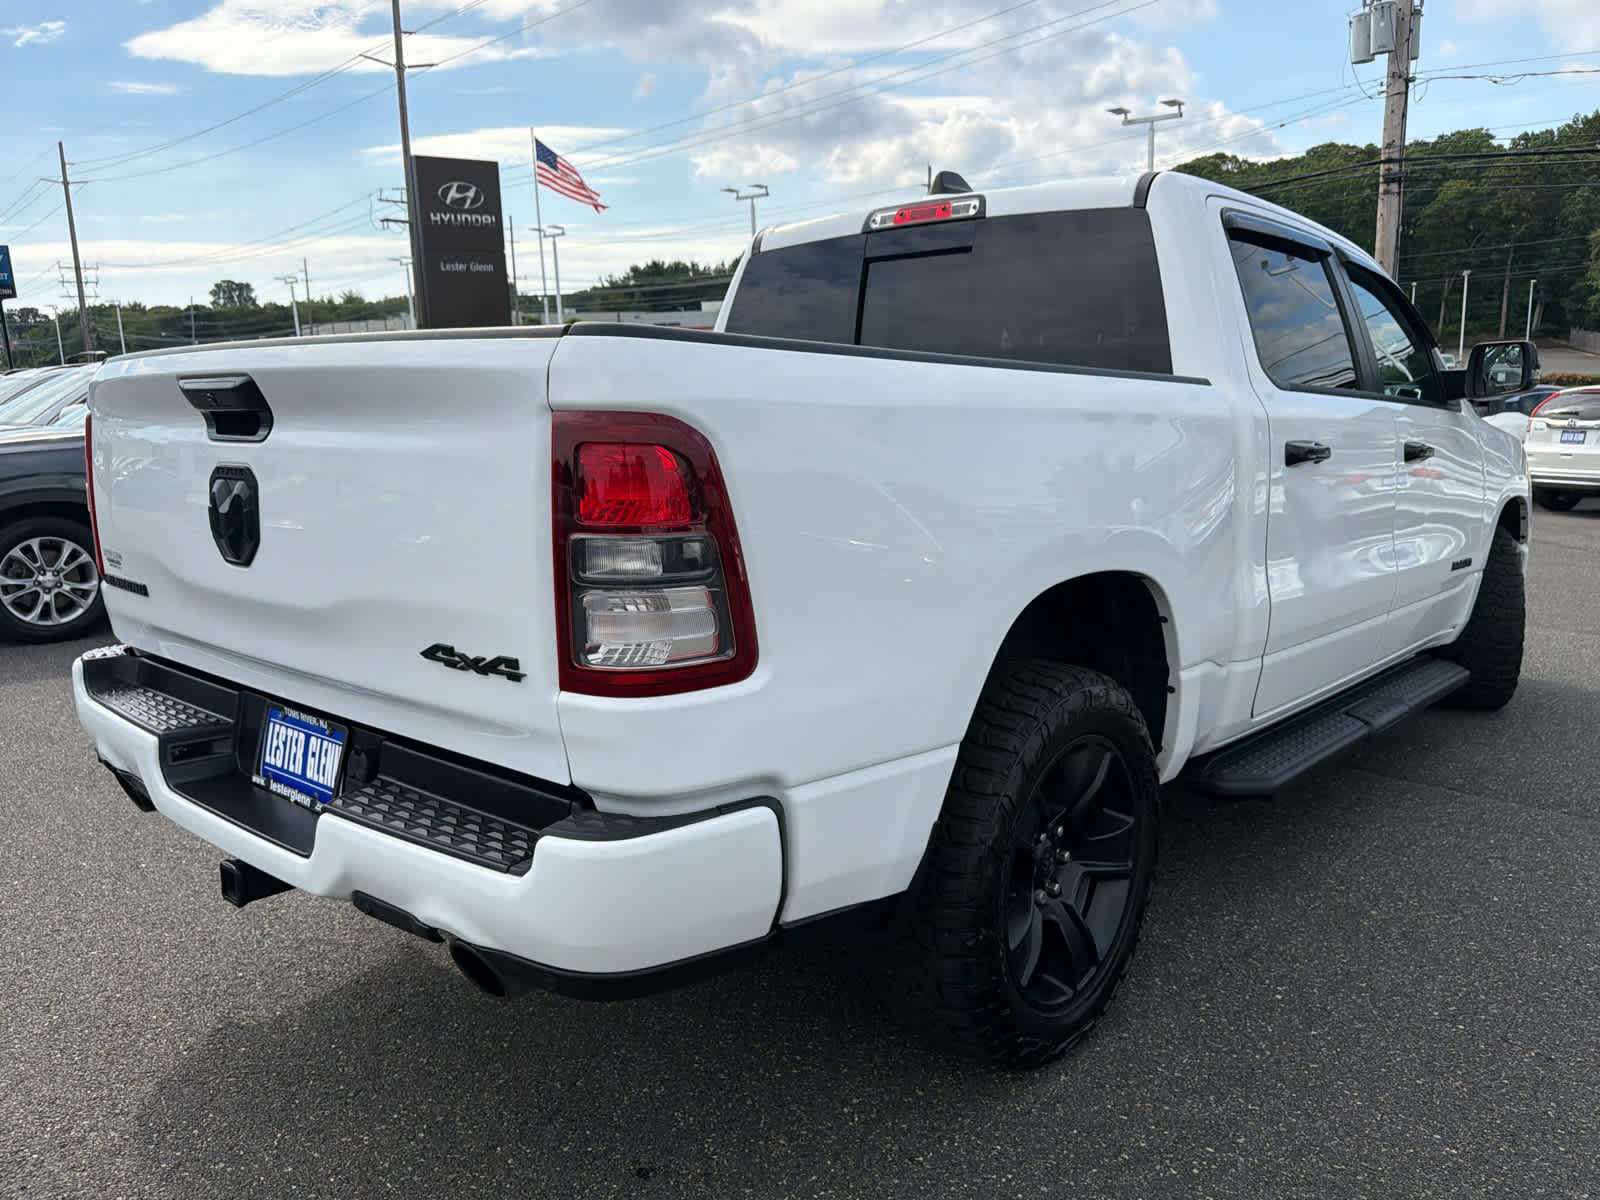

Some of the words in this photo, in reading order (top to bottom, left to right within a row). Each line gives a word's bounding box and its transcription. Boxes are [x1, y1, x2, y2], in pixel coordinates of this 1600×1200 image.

[430, 212, 496, 227] HYUNDAI
[440, 261, 467, 272] Lester
[470, 262, 494, 272] Glenn
[265, 722, 306, 775] LESTER
[306, 736, 342, 788] GLENN
